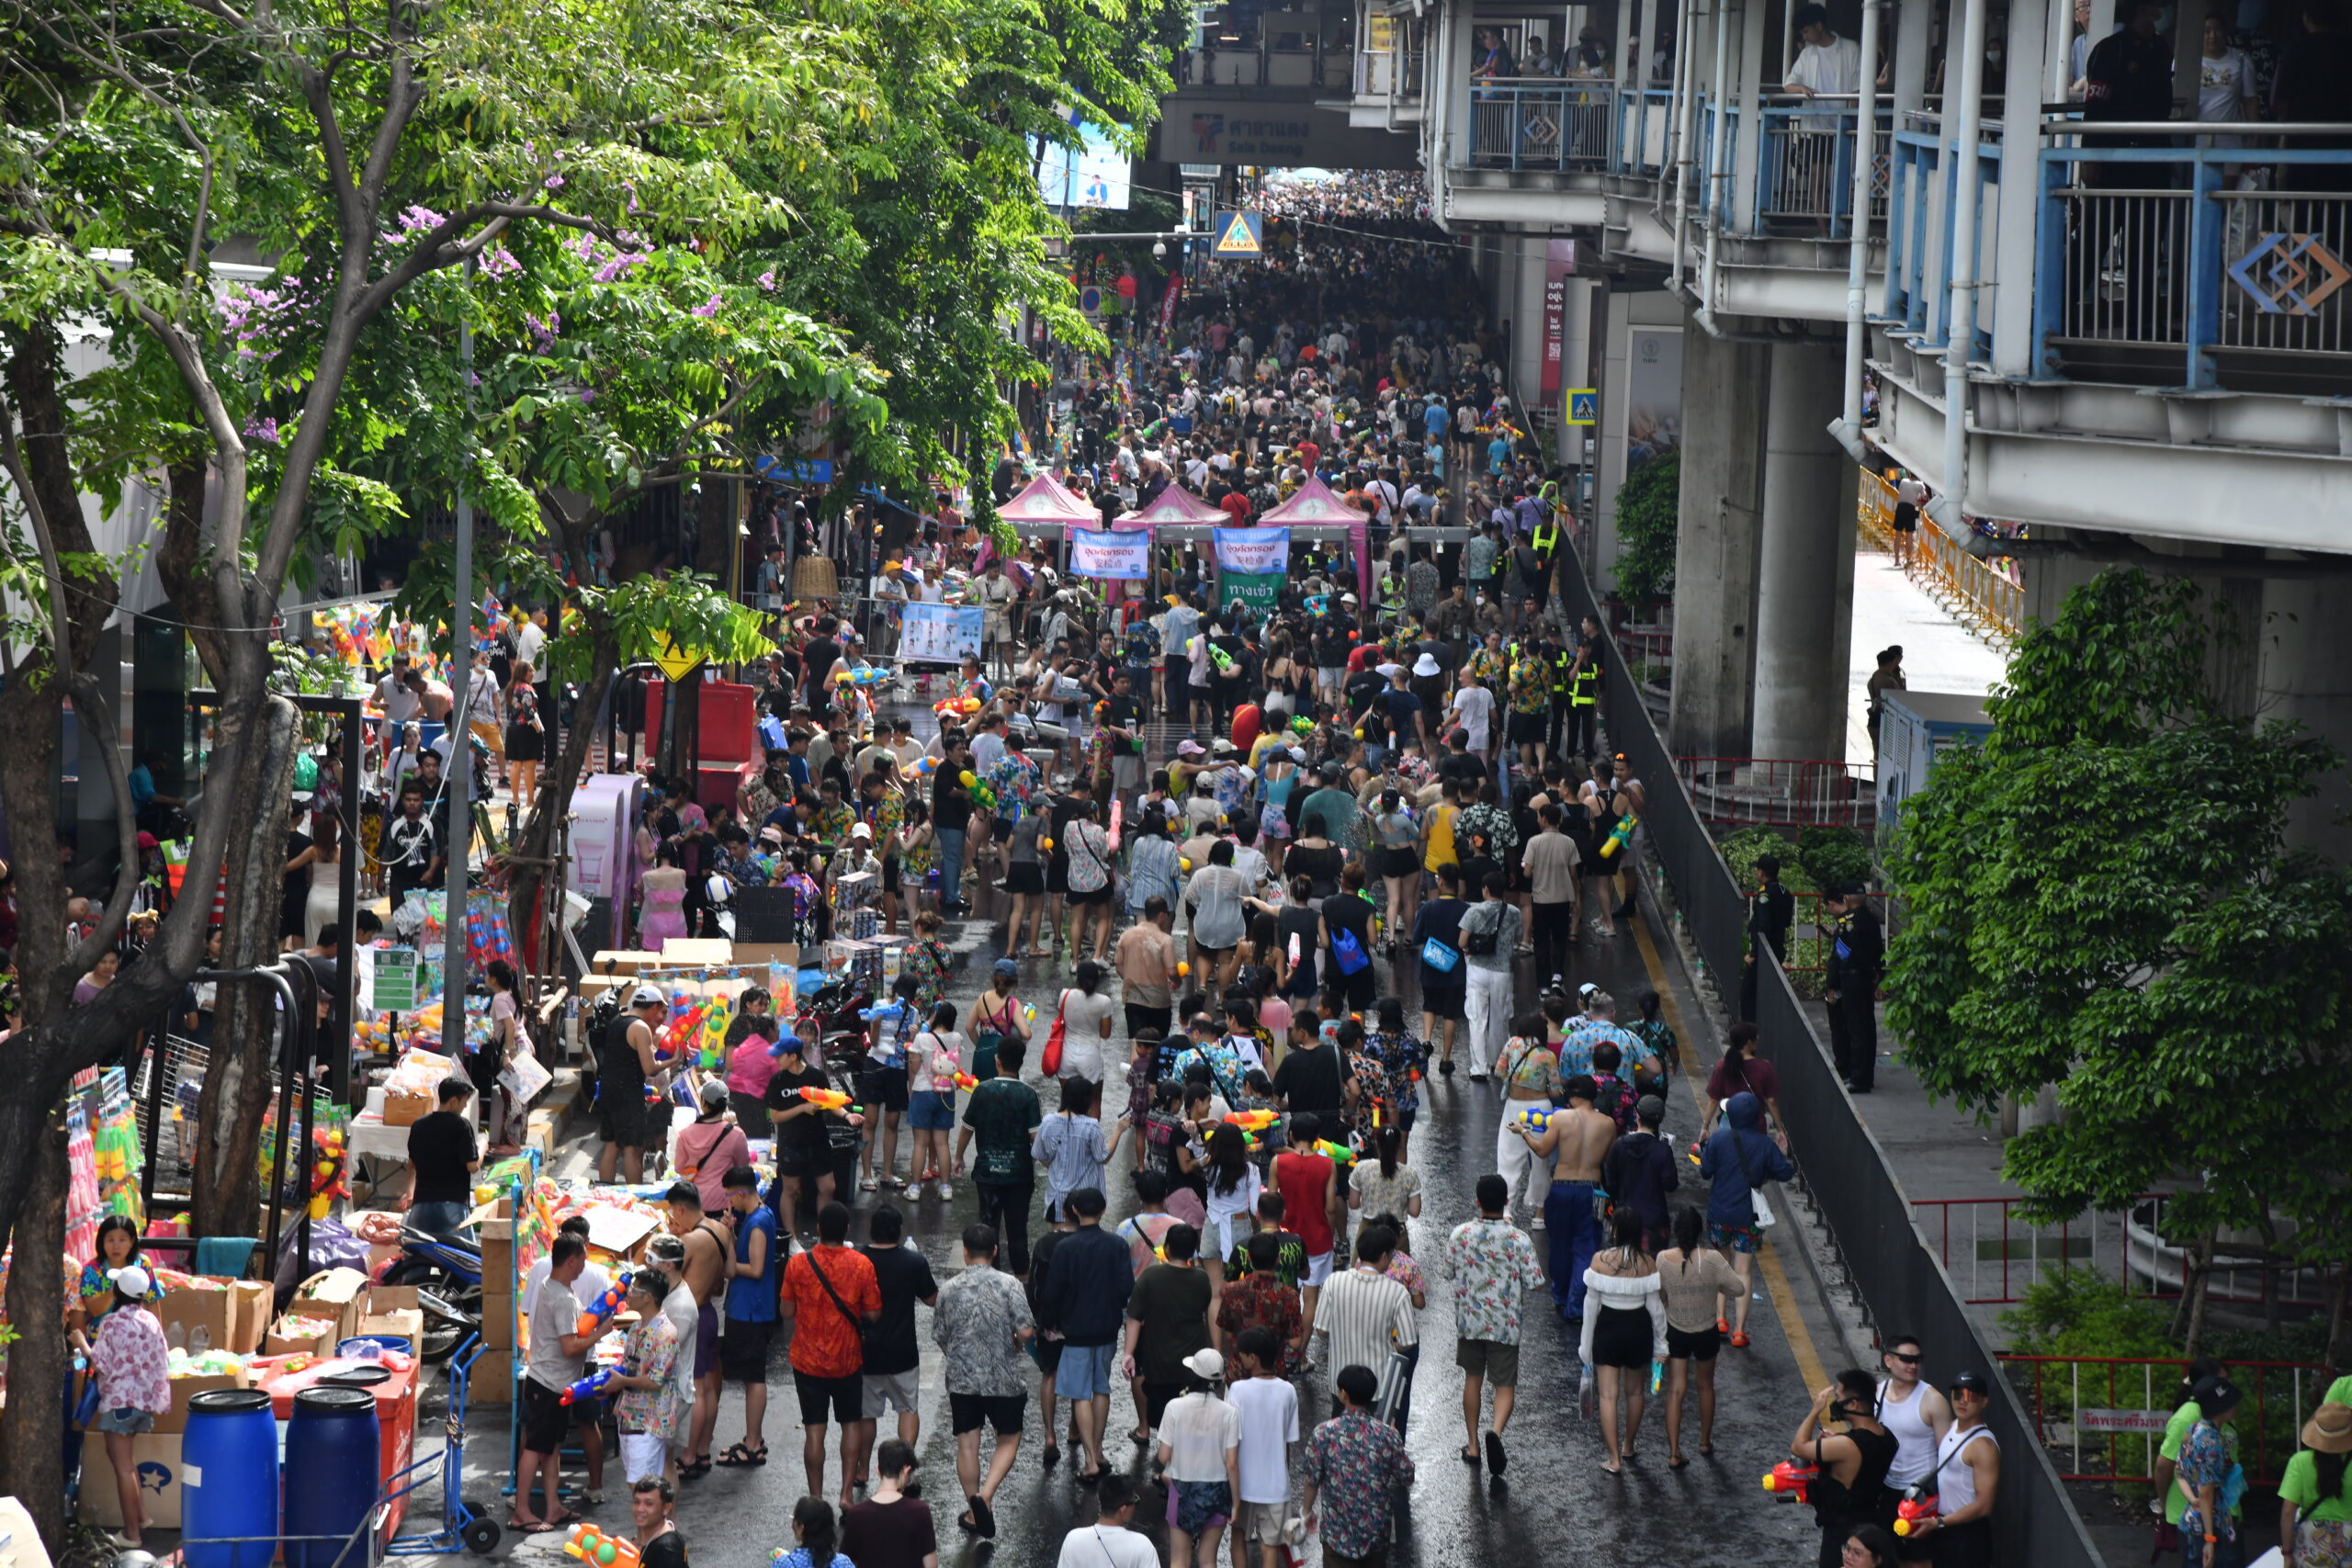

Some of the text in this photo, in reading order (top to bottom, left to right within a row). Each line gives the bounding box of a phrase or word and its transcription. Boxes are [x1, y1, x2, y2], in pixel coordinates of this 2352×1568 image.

[1230, 119, 1308, 137] ศาลาแดง
[1229, 141, 1303, 157] Sala Daeng
[1085, 547, 1134, 558] จุดคัดกรอง
[1229, 582, 1273, 597] ทางเข้า
[2085, 1412, 2166, 1427] วัดพระศรีมหา
